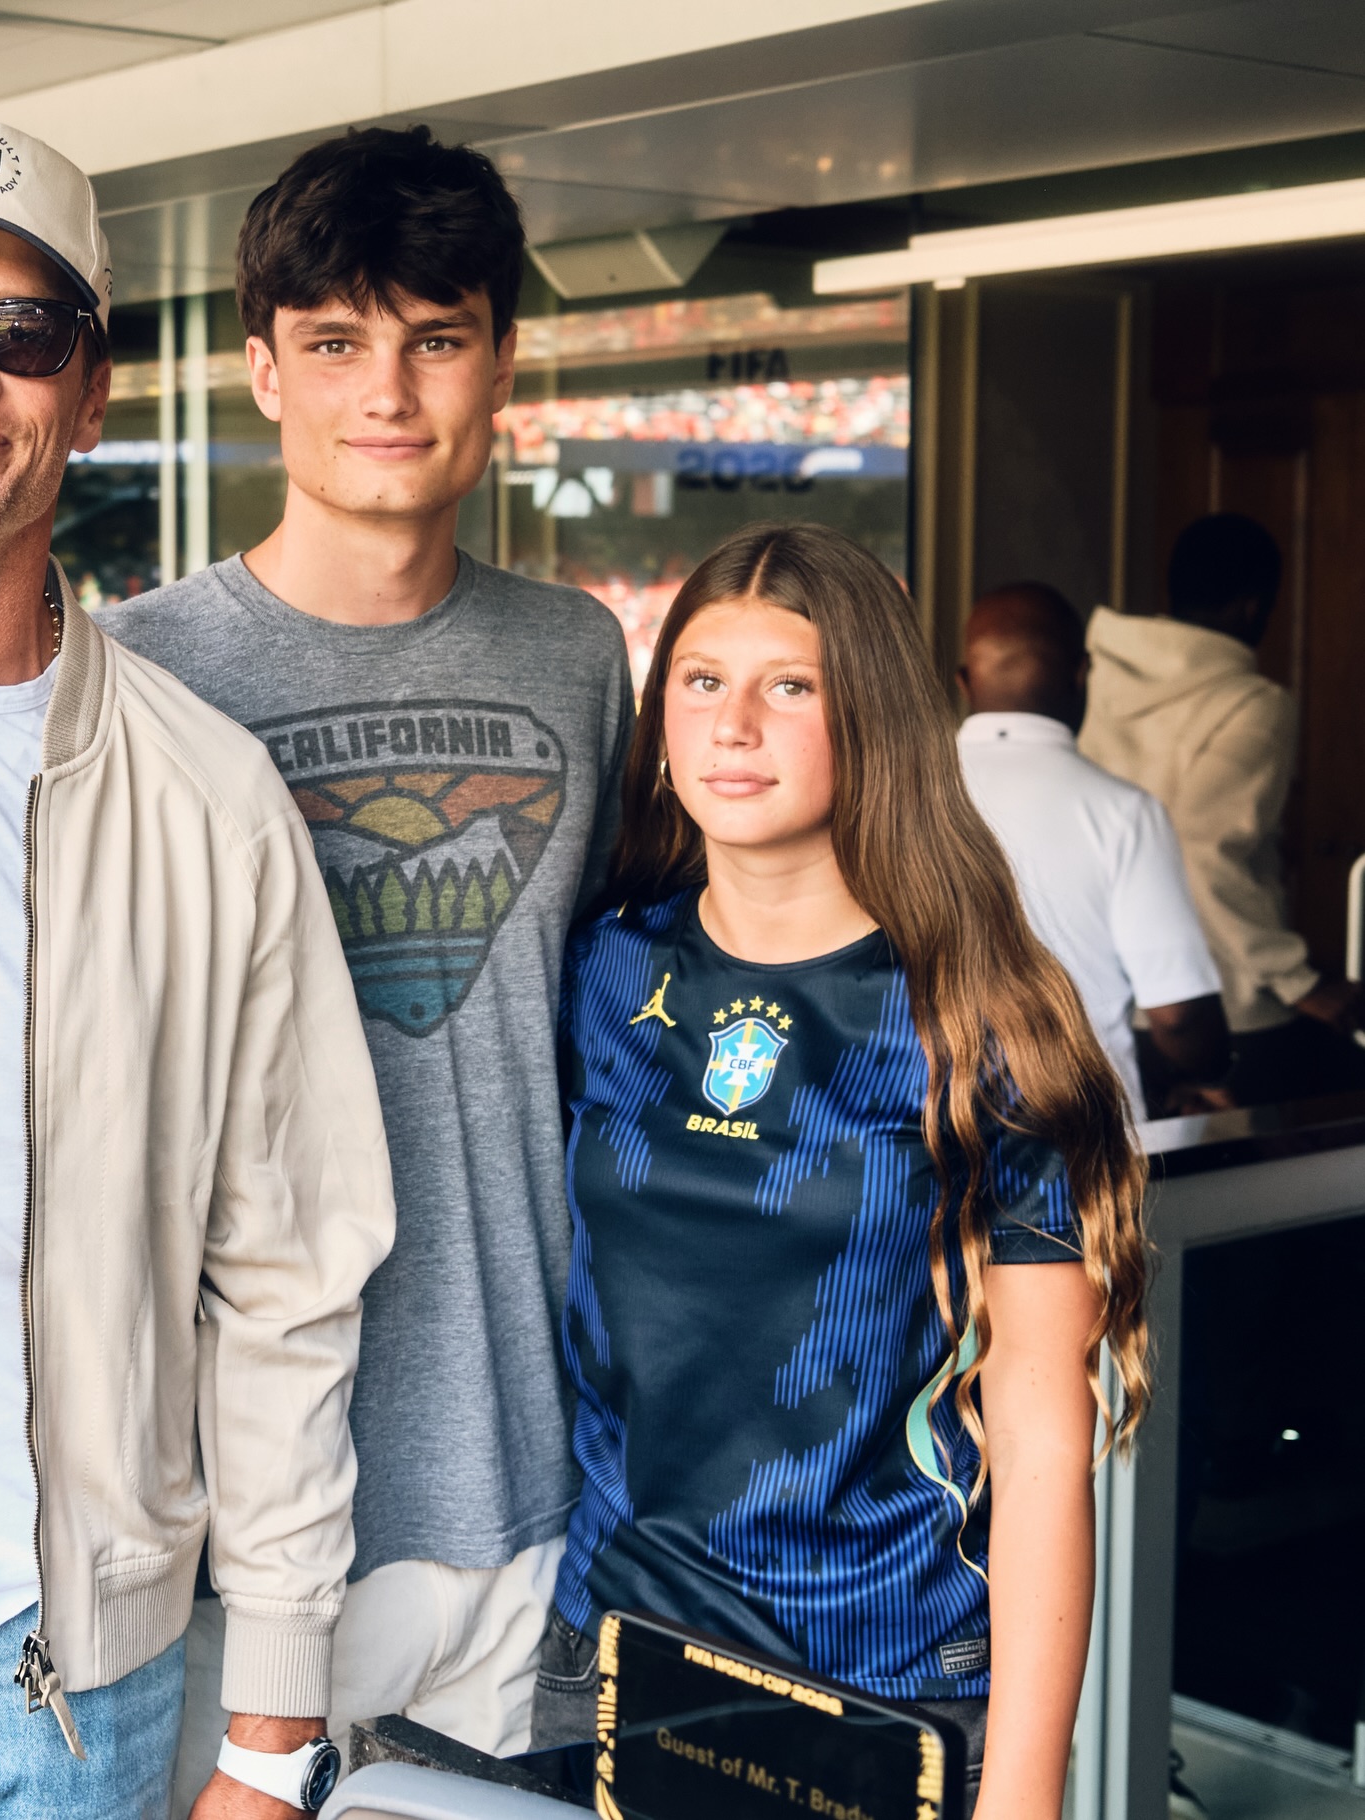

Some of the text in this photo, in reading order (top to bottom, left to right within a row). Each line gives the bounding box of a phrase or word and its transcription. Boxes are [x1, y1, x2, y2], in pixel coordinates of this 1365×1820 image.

[266, 717, 513, 772] CALIFORNIA
[729, 1058, 757, 1071] CBF
[686, 1114, 760, 1140] BRASIL
[657, 1726, 715, 1769] Guest
[720, 1757, 742, 1779] of
[747, 1763, 780, 1794] Mr.
[786, 1778, 804, 1804] T.
